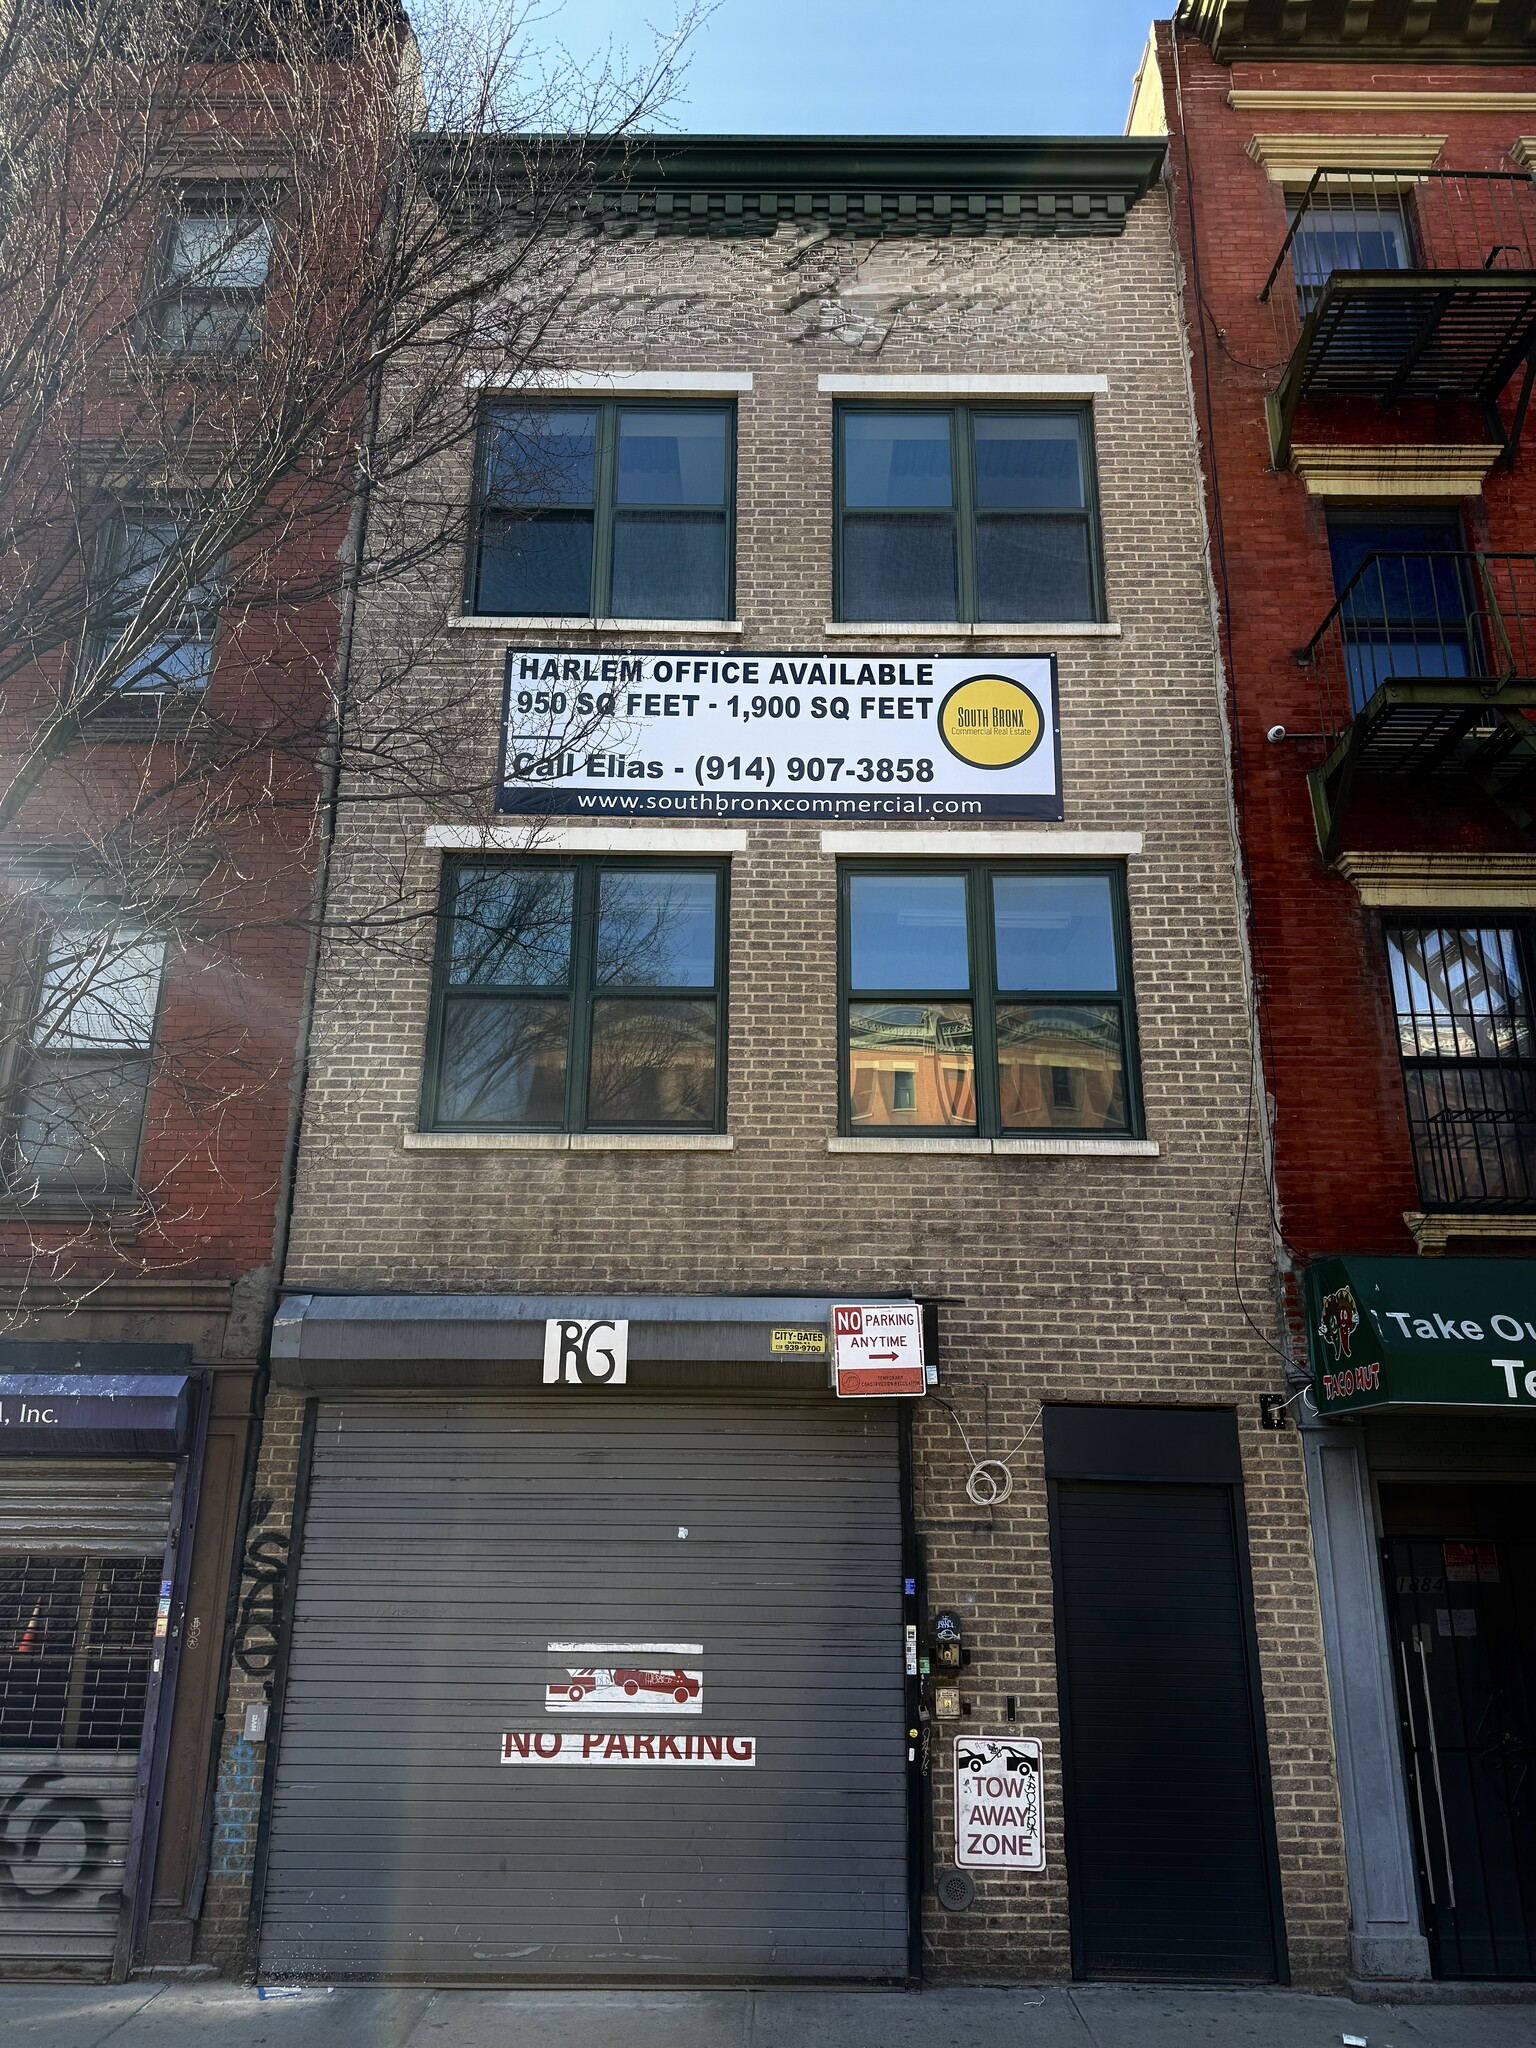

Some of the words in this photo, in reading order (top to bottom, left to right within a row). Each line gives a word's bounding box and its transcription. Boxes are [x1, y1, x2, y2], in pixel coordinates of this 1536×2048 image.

[519, 658, 643, 683] HARLEM
[653, 660, 759, 684] OFFICE
[768, 662, 934, 686] AVAILABLE
[517, 690, 567, 715] 950
[577, 692, 616, 717] SQ
[627, 693, 700, 717] FEET
[727, 694, 800, 723] 1,900
[810, 696, 850, 720] SQ
[860, 697, 934, 720] FEET
[951, 727, 992, 735] Commercial
[993, 728, 1009, 736] Real
[1010, 728, 1031, 736] Estate
[513, 752, 575, 777] Call
[586, 753, 664, 779] Elias
[695, 755, 775, 787] (914)
[787, 757, 934, 782] 907-3858
[577, 793, 983, 814] www.southbronxcommercial.com
[838, 1311, 861, 1331] NO
[865, 1313, 915, 1327] PARKING
[1385, 1312, 1485, 1341] Take
[774, 1331, 823, 1342] CITY-GATES
[850, 1335, 908, 1348] ANYTIME
[1323, 1369, 1354, 1401] TACO
[20, 1403, 59, 1424] Inc.
[1399, 1577, 1443, 1592] 1884
[504, 1733, 562, 1759] NO
[583, 1733, 754, 1761] PARKING
[972, 1776, 1025, 1798] TOW
[968, 1805, 1029, 1827] AWAY
[967, 1833, 1033, 1856] ZONE
